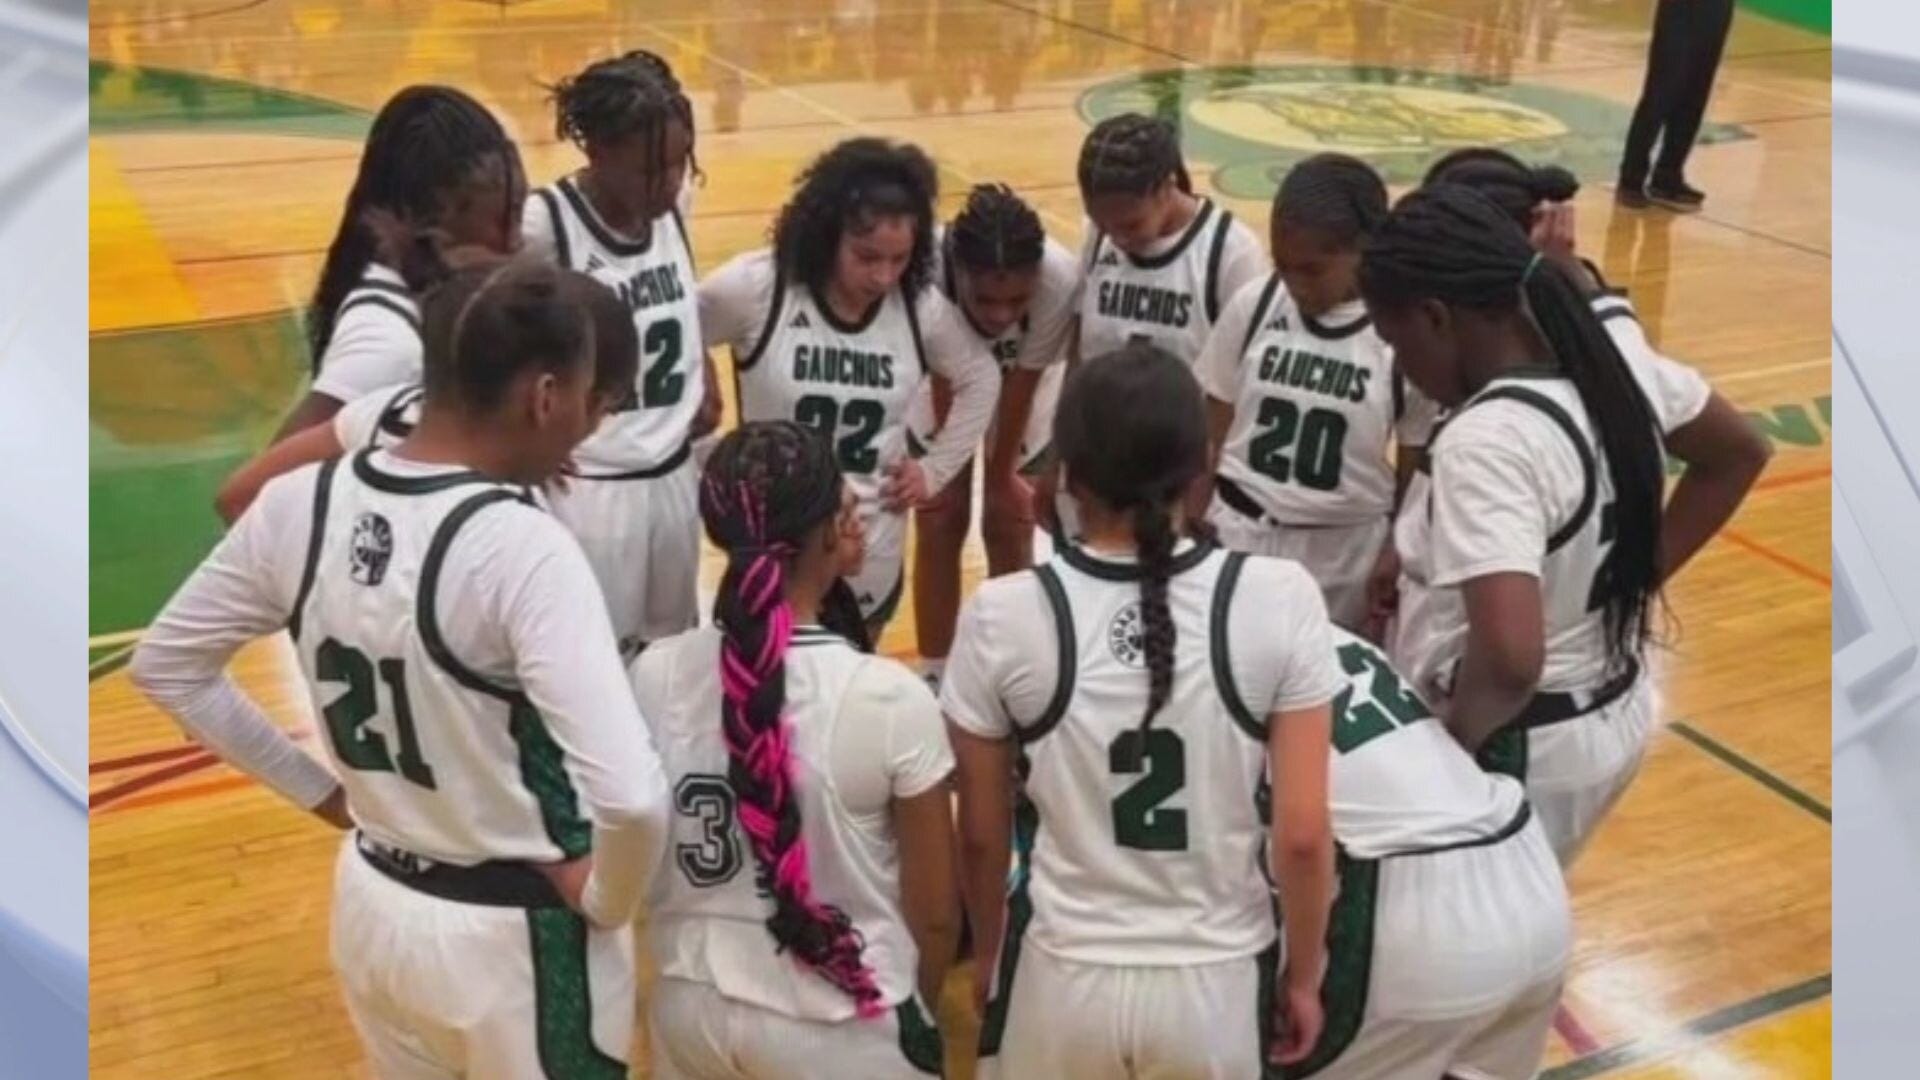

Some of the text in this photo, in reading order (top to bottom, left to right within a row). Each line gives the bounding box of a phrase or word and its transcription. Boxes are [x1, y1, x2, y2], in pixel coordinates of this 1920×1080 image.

[1098, 281, 1192, 328] GAUCHOS
[794, 345, 894, 389] GAUCHOS
[1258, 345, 1371, 403] GAUCHOS
[1248, 396, 1348, 491] 20
[316, 637, 437, 790] 21
[1109, 728, 1188, 851] 2
